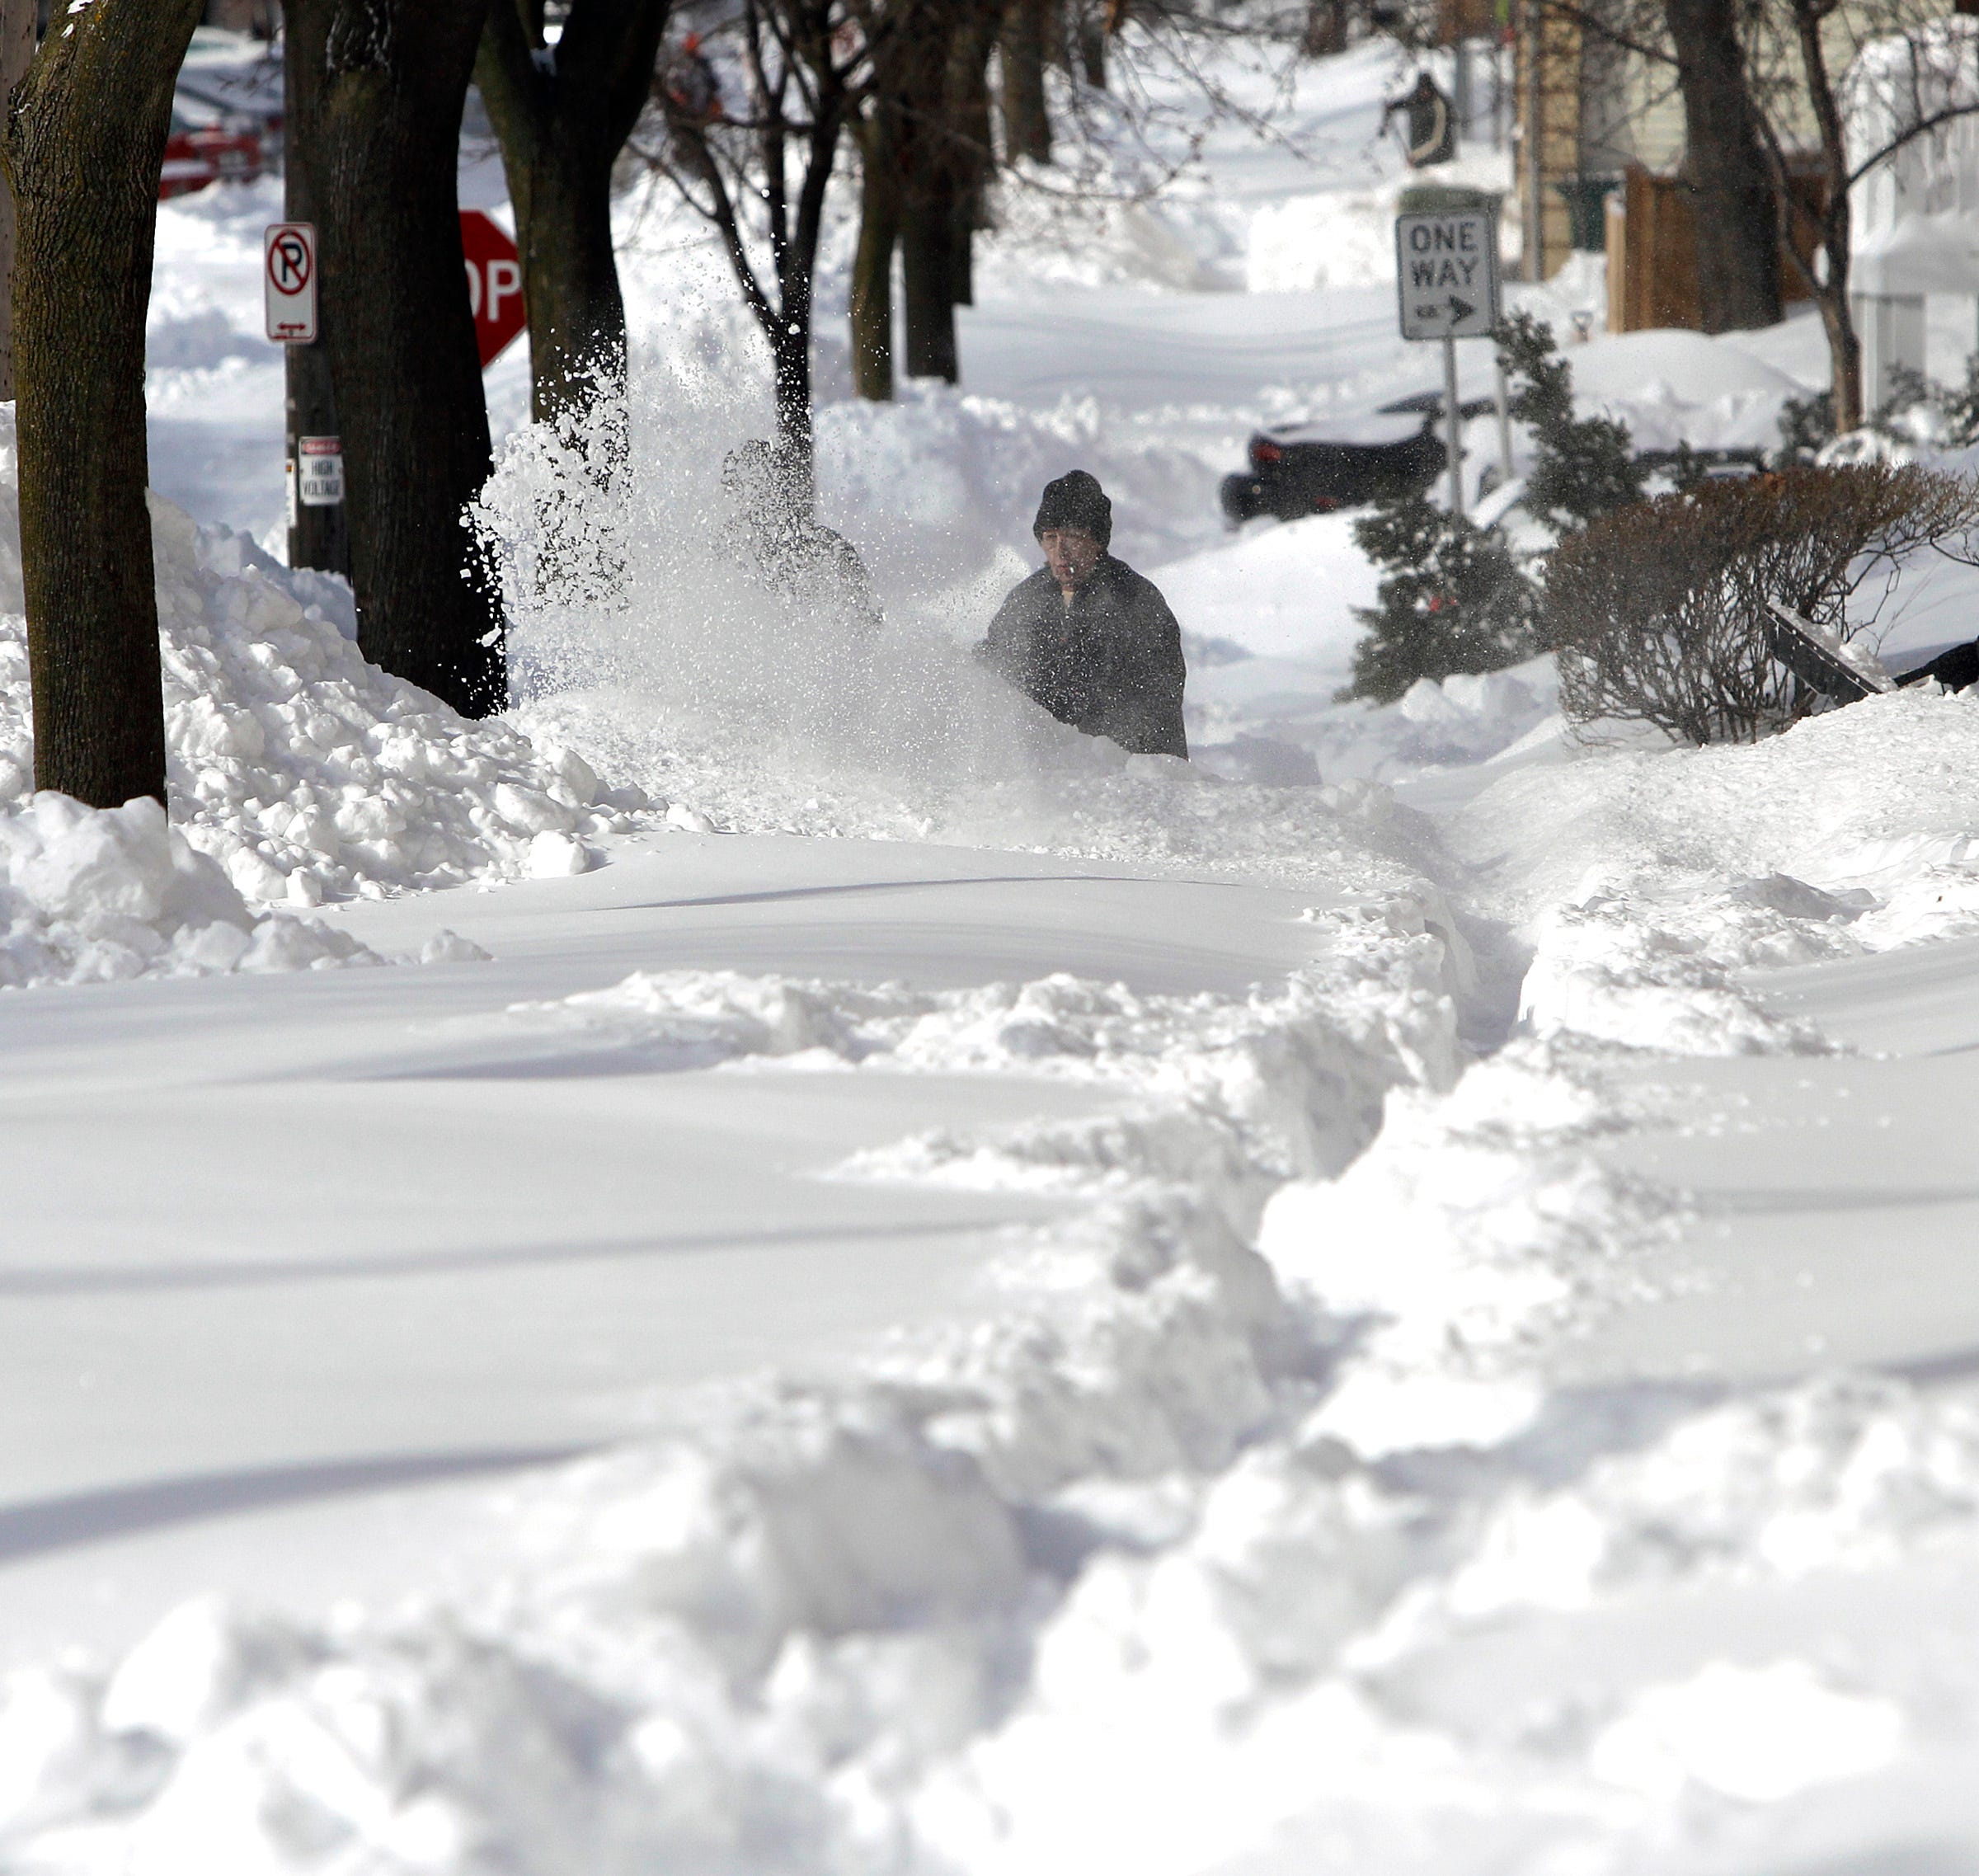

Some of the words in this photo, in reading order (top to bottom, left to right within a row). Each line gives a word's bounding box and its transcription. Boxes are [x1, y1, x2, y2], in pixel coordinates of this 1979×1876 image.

[1411, 222, 1477, 252] ONE
[282, 242, 303, 282] P
[1411, 256, 1478, 288] WAY
[312, 461, 333, 475] HIGH
[303, 480, 340, 496] VOLTAGE
